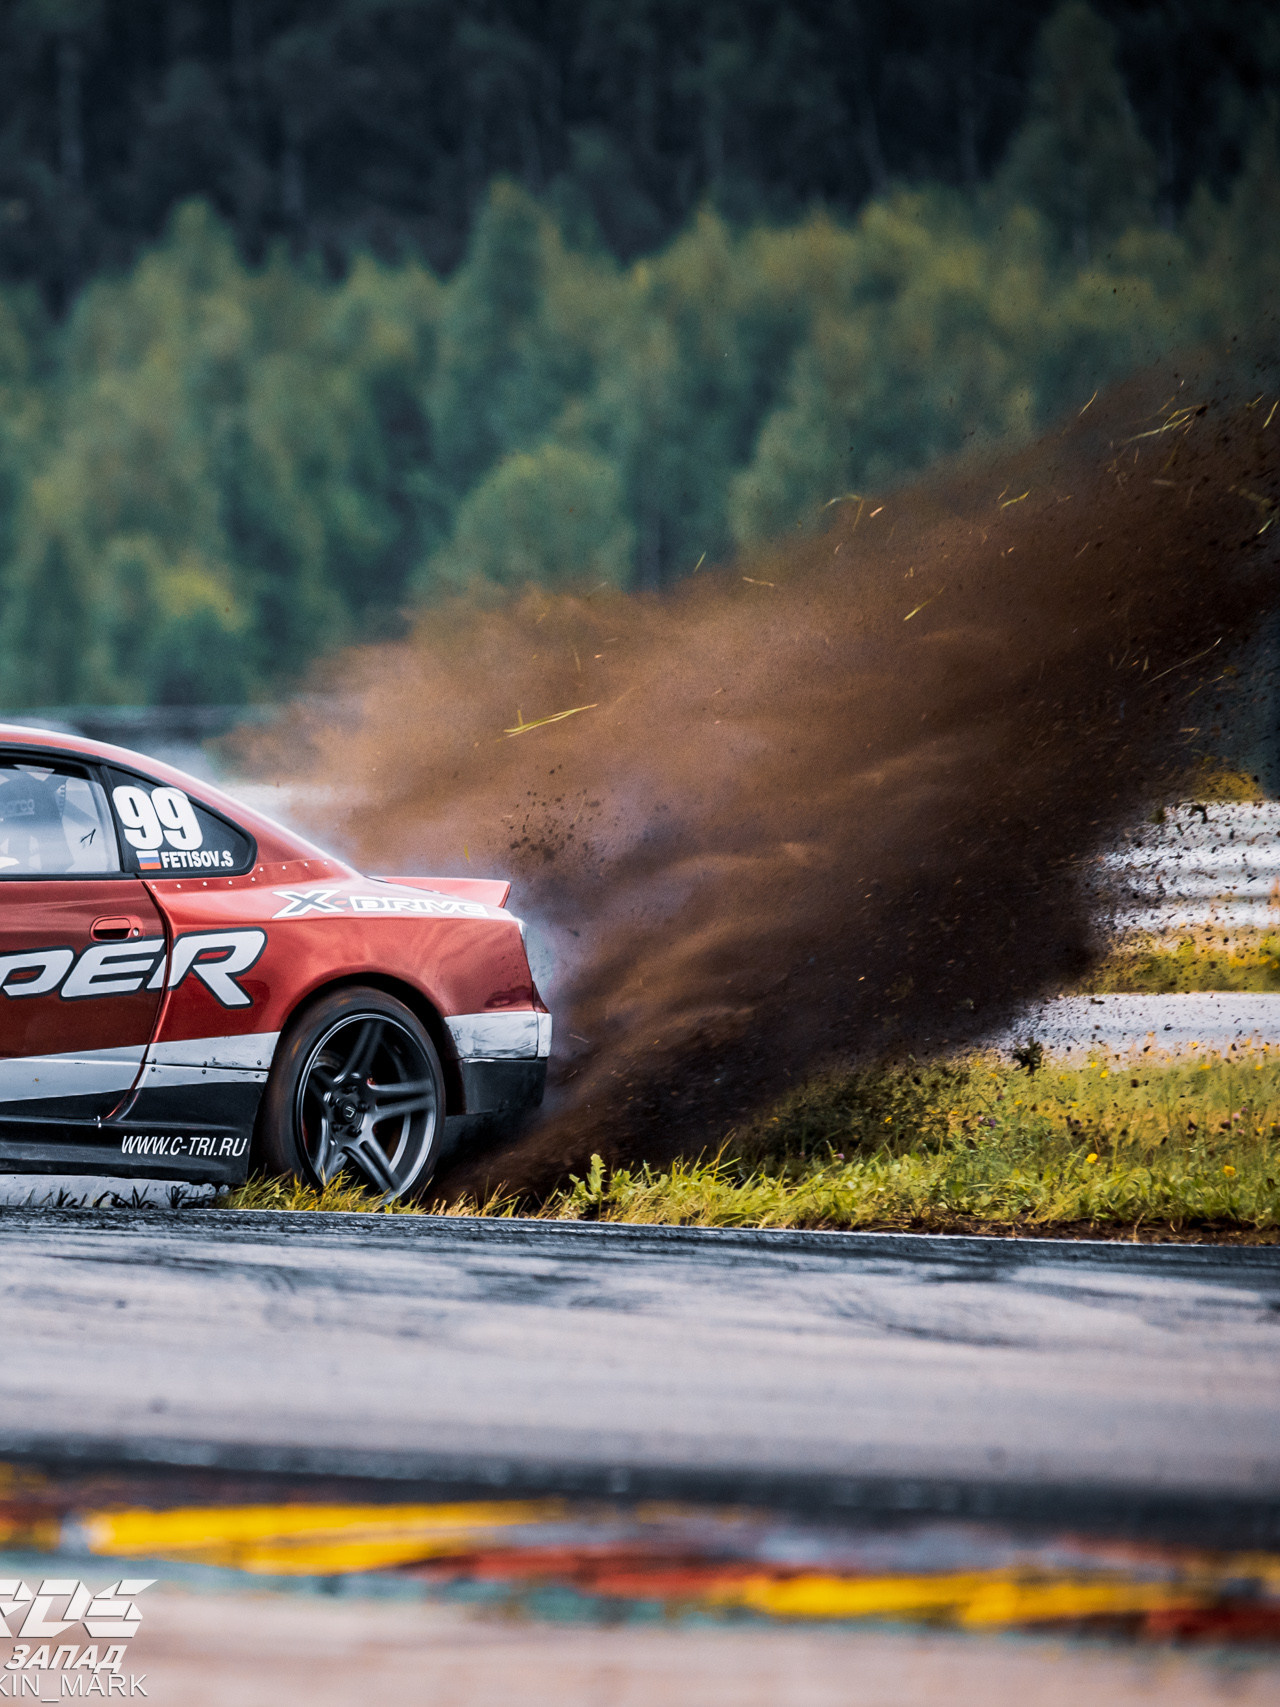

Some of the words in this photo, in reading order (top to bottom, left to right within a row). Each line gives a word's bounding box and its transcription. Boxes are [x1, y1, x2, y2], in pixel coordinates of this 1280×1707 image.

[112, 786, 203, 850] 99
[160, 850, 234, 868] FETISOV.S
[121, 1135, 248, 1157] WWW.C-TRI.RU
